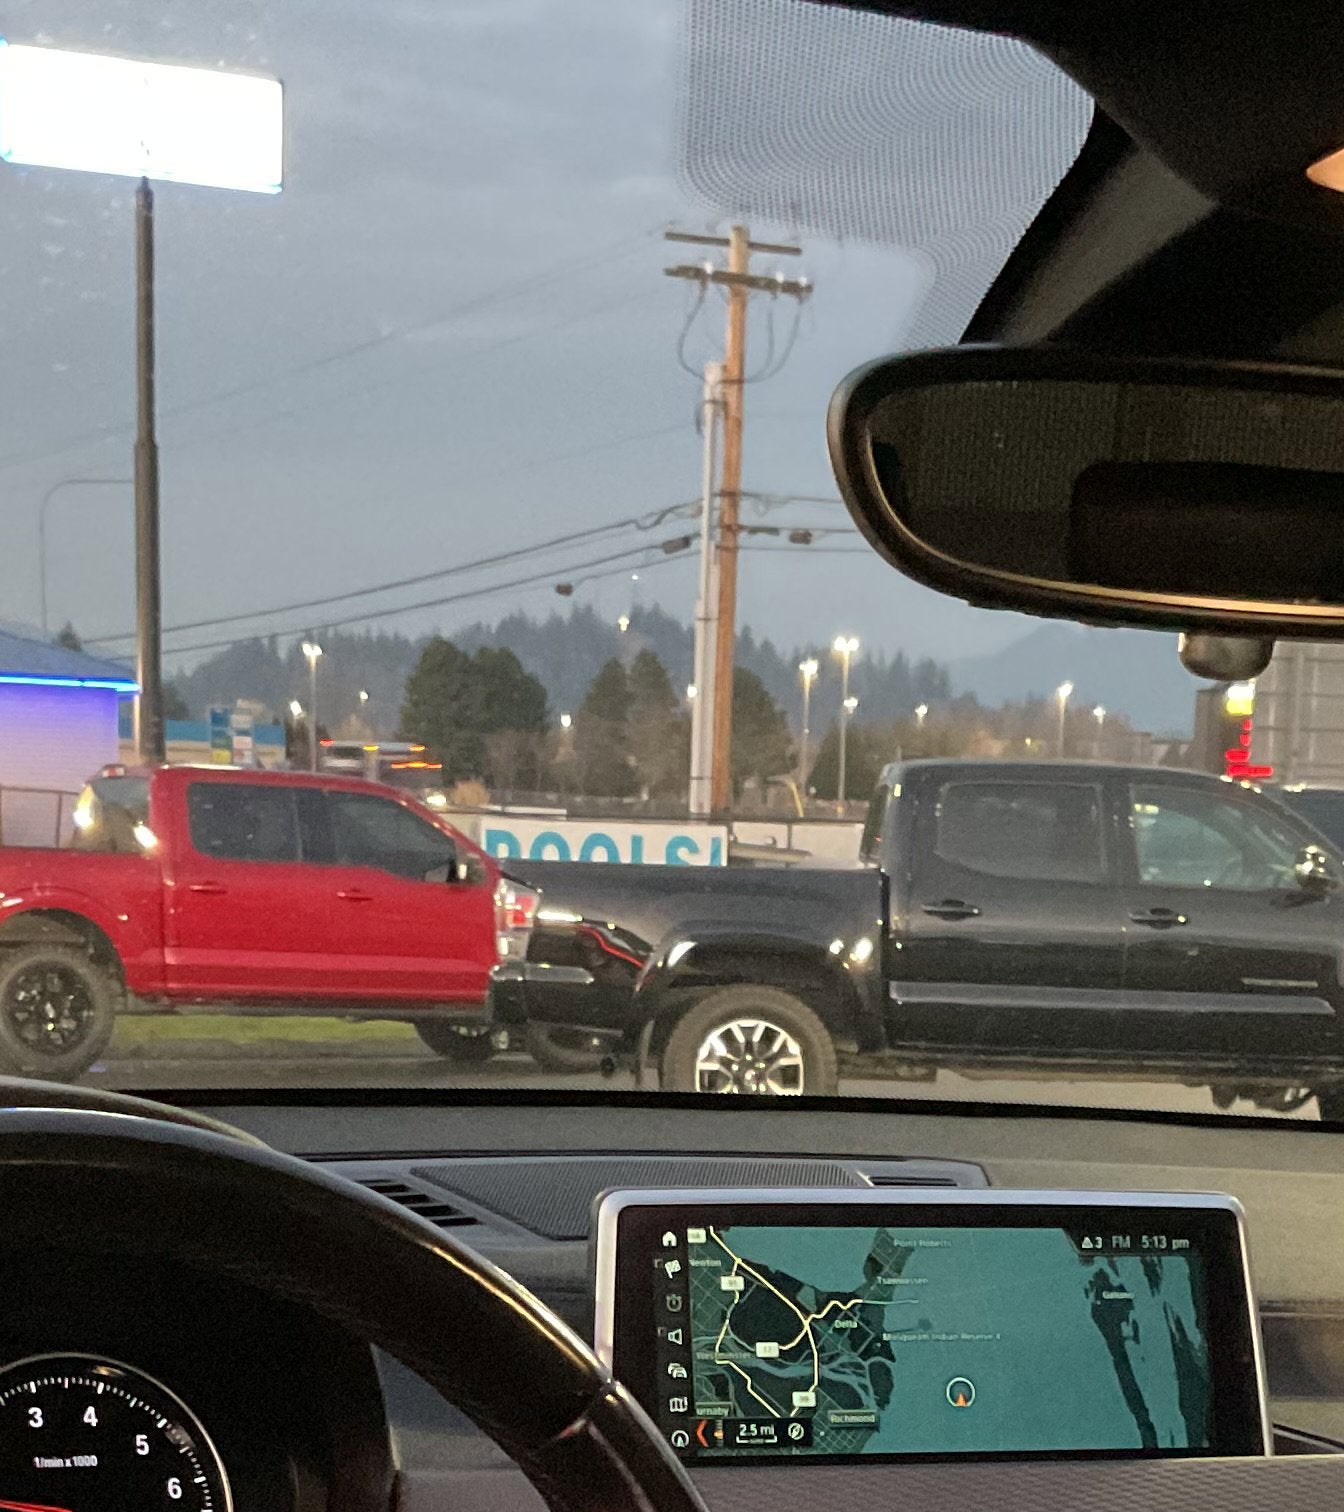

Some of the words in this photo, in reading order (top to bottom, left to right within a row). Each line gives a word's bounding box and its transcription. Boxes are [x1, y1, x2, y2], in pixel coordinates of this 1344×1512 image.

[1095, 1236, 1103, 1249] 3
[1111, 1235, 1131, 1249] FM
[1141, 1234, 1167, 1249] 5:13
[1172, 1239, 1190, 1250] pm
[27, 1407, 44, 1428] 3
[83, 1406, 99, 1427] 4
[830, 1413, 876, 1423] Richmond
[739, 1424, 757, 1436] 2.5
[760, 1423, 775, 1436] mi
[135, 1434, 150, 1455] 5
[167, 1477, 183, 1499] 6
